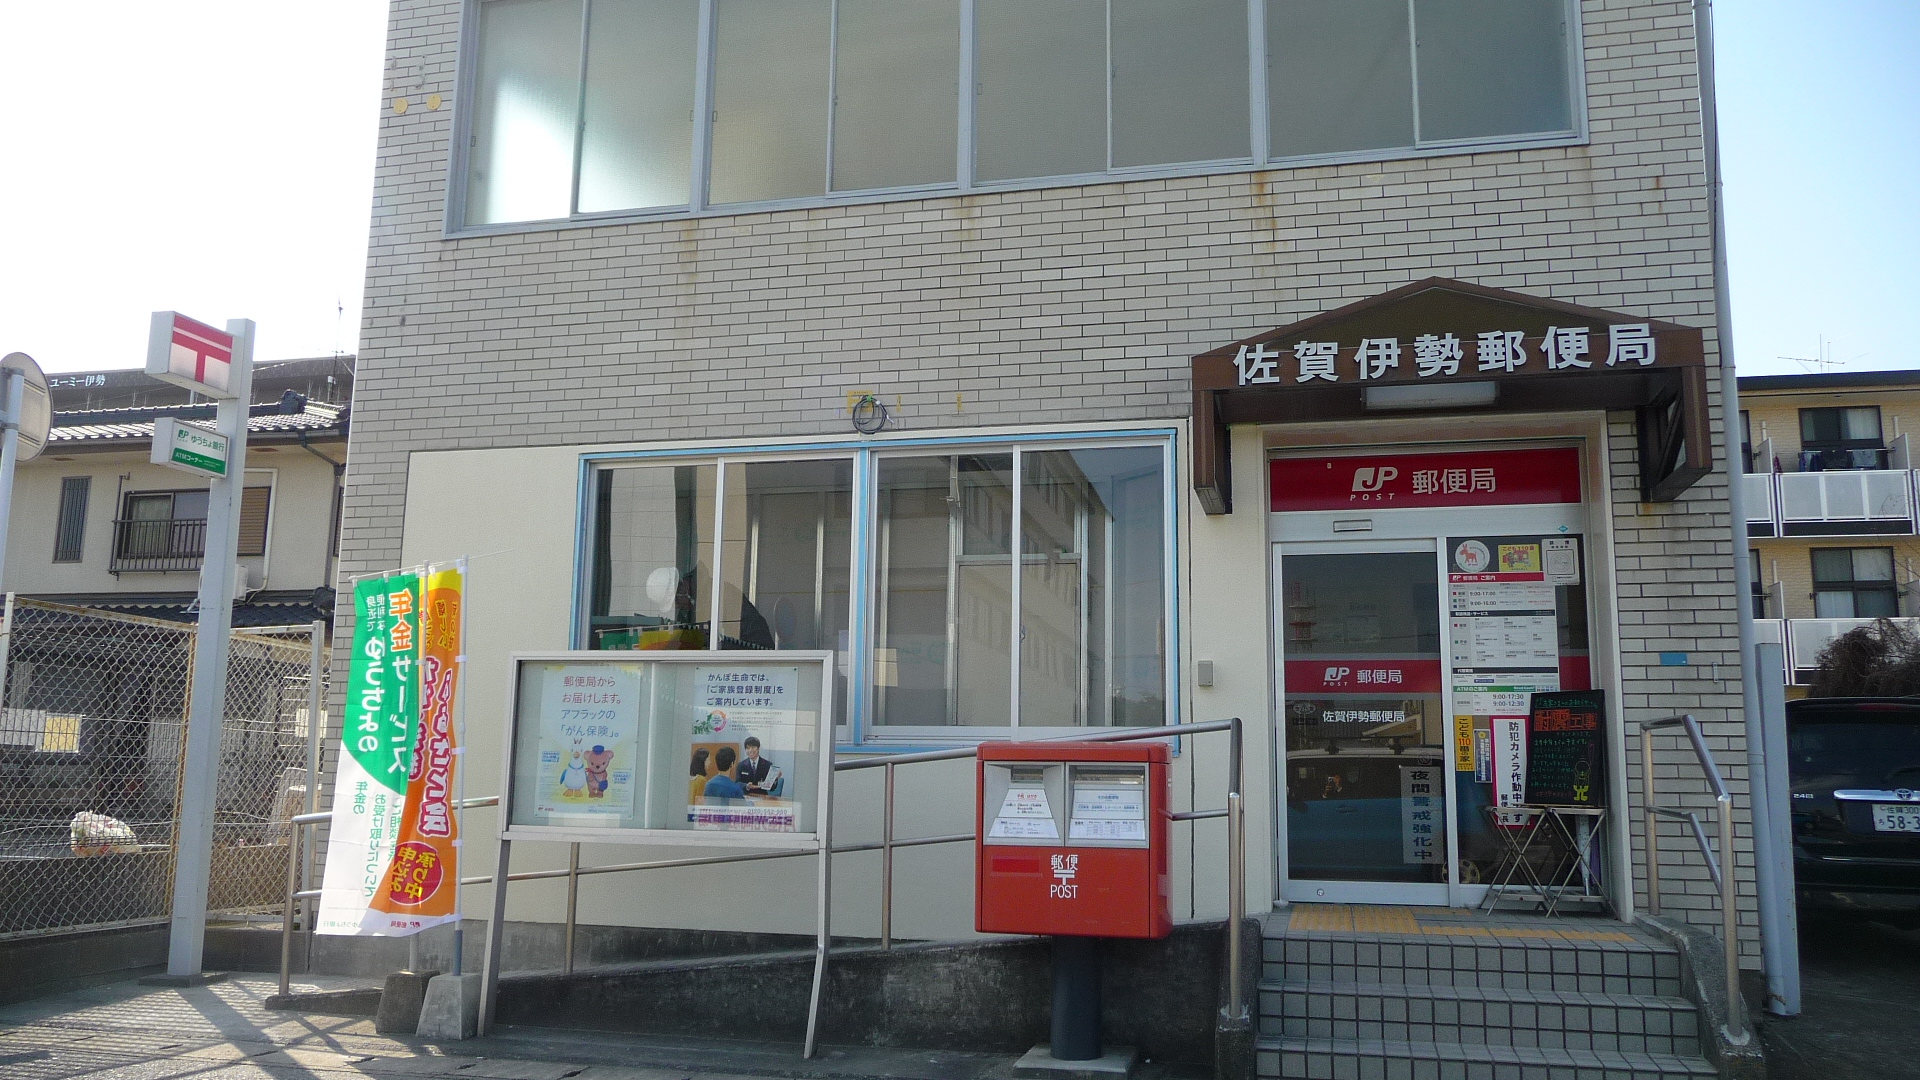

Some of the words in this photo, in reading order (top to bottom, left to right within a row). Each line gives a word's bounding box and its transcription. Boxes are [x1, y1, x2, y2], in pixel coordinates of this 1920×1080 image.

[1233, 323, 1657, 386] 佐賀伊勢郵便局
[49, 374, 106, 388] ユーミー伊勢
[191, 435, 225, 452] ゆうちょ銀行
[175, 452, 203, 463] ATMコーナー
[1412, 468, 1496, 494] 郵便局
[1350, 492, 1395, 501] POST
[563, 676, 616, 688] 郵便局から
[707, 673, 770, 682] かんぽ生命では、
[1357, 669, 1403, 684] 郵便局
[706, 685, 784, 695] 「ご家族登録制度」を
[562, 692, 621, 705] お届けします。
[706, 698, 774, 707] ご案内しています。
[561, 709, 616, 720] アフラックの
[1322, 709, 1405, 723] 佐賀伊勢郵便局
[560, 725, 620, 738] 「がん保険」。
[1457, 718, 1471, 763] こども110番の家
[1410, 770, 1433, 860] 夜間警戒強化中
[1500, 794, 1509, 823] 郵便長
[1050, 854, 1079, 871] 郵便
[1050, 884, 1078, 899] POST
